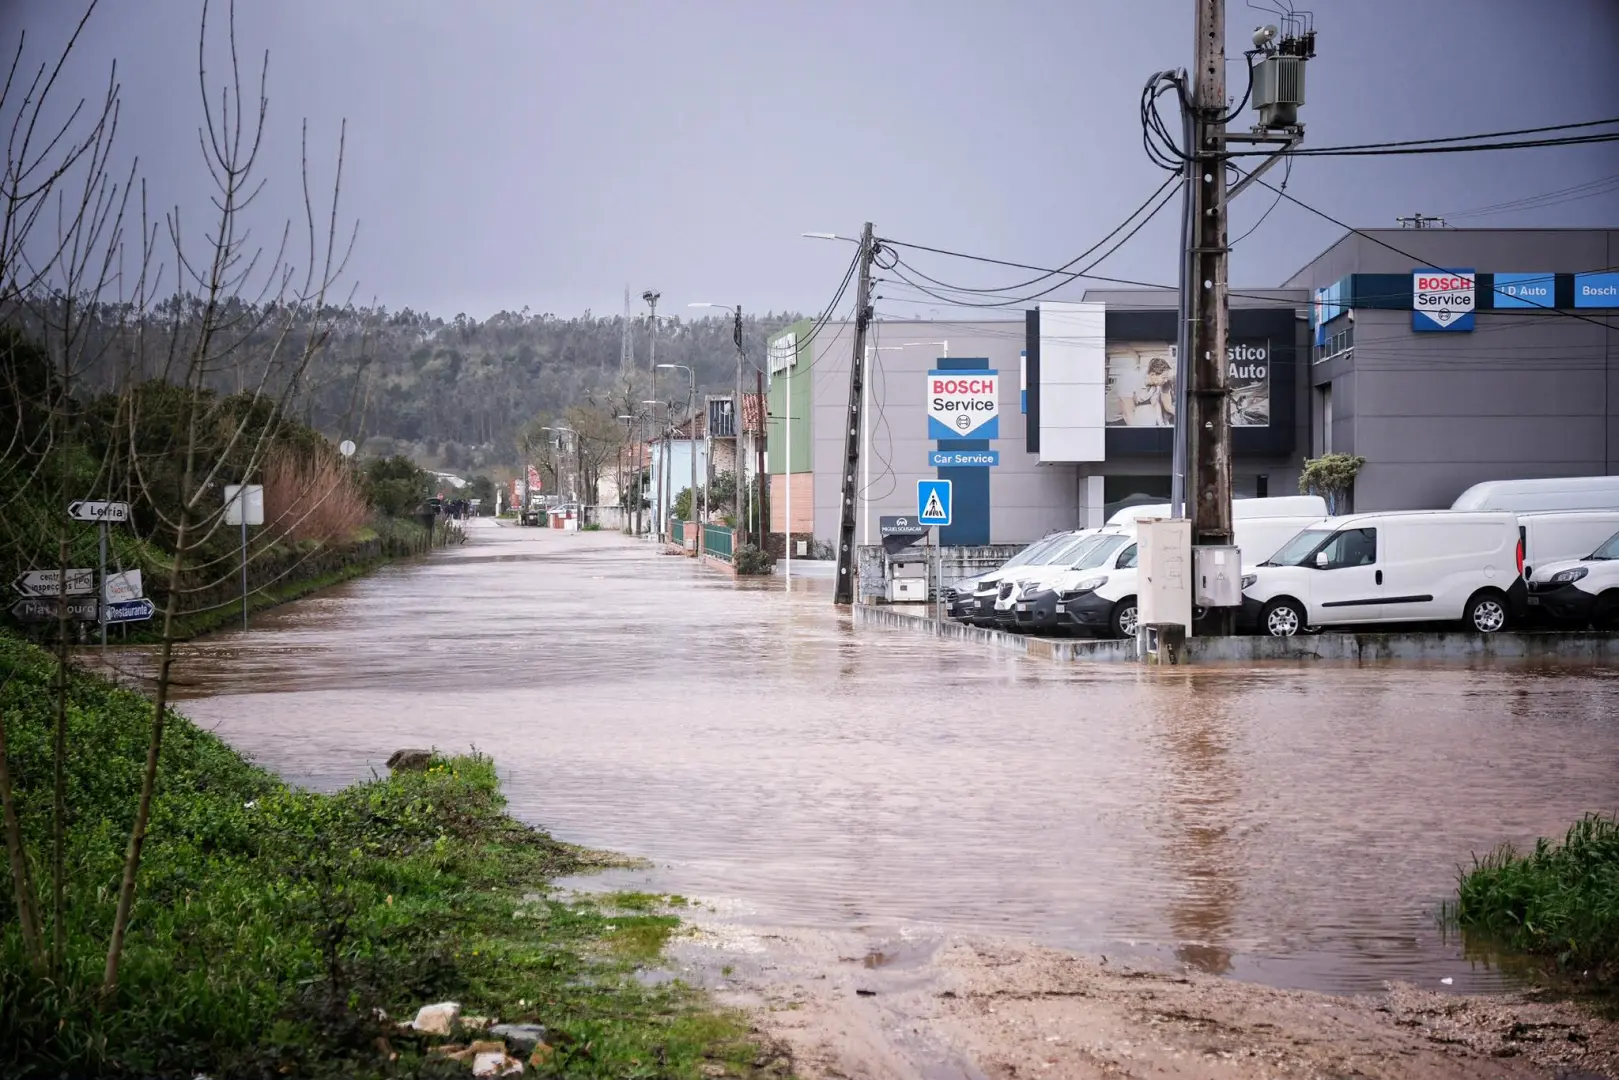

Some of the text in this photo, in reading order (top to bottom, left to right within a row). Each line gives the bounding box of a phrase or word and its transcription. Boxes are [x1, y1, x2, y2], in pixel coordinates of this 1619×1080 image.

[1418, 277, 1471, 290] BOSCH
[1520, 286, 1547, 296] Auto
[1582, 285, 1617, 296] Bosch
[1418, 293, 1471, 305] Service
[1228, 363, 1266, 379] Auto
[933, 380, 994, 394] BOSCH
[933, 397, 994, 411] Service
[934, 454, 994, 463] Car Service
[110, 604, 148, 618] Restaurante
